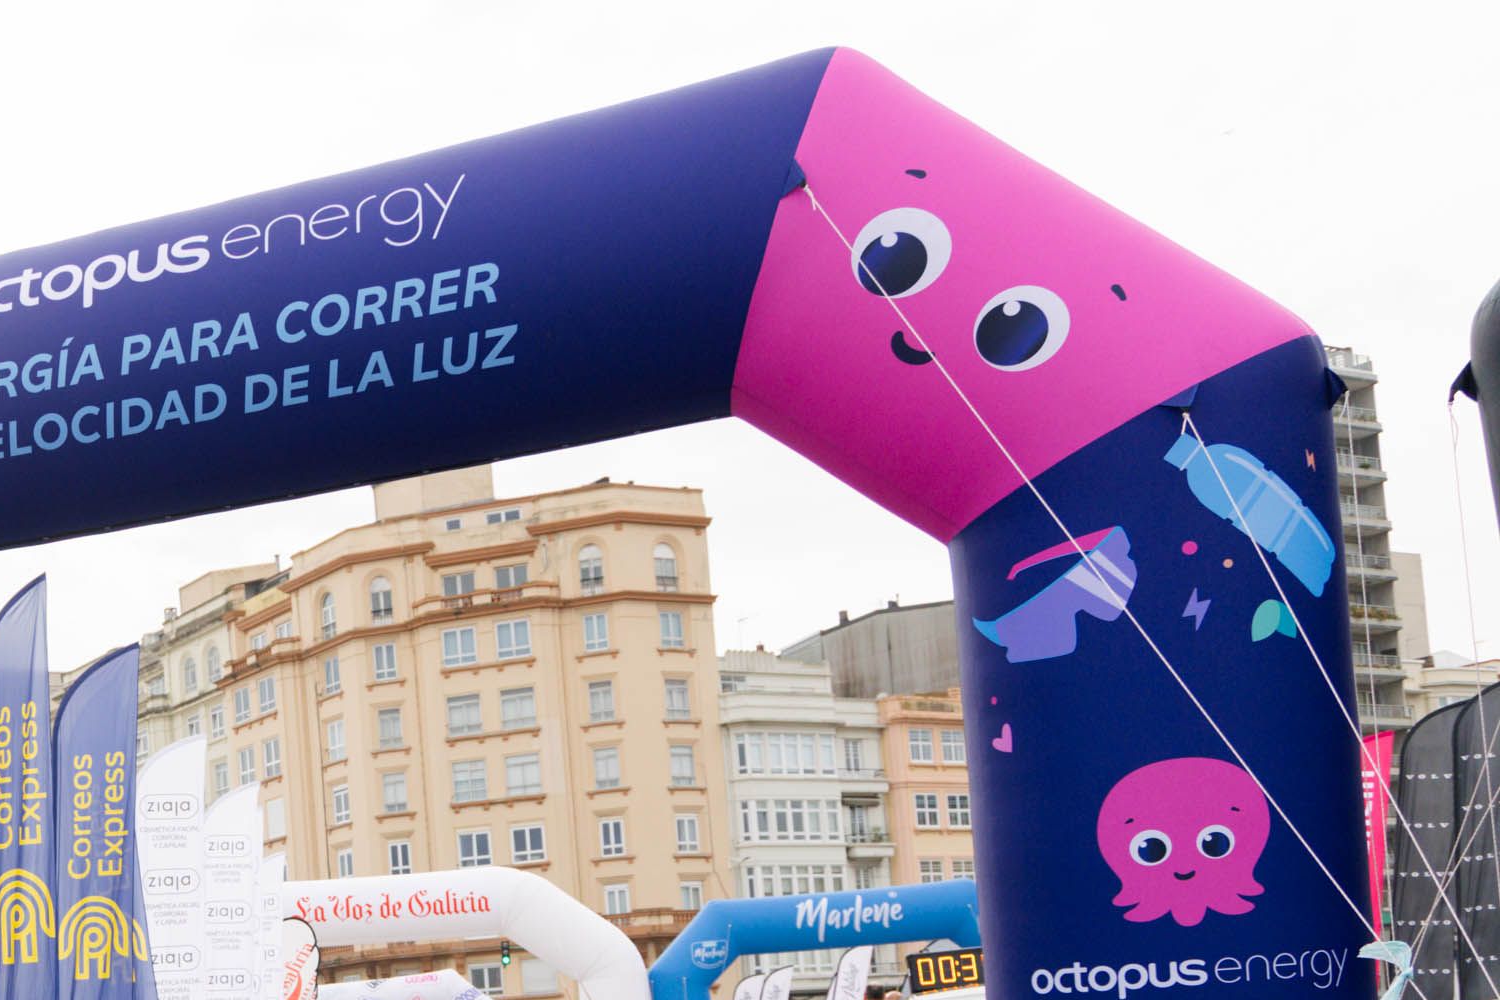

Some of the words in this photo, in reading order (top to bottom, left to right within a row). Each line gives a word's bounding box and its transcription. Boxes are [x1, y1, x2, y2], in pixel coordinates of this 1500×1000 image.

[220, 173, 465, 259] energy
[120, 312, 260, 376] PARA
[276, 262, 500, 343] CORRER
[245, 364, 309, 414] DE
[328, 351, 394, 398] LA
[412, 324, 518, 382] LUZ
[18, 700, 47, 847] Express
[67, 753, 93, 880] Correos
[97, 751, 129, 877] Express
[147, 801, 190, 816] ziaja
[208, 839, 245, 855] ziaja
[148, 875, 191, 891] ziaja
[329, 894, 372, 924] Voz
[379, 893, 402, 920] de
[408, 889, 491, 917] Galicia
[207, 906, 244, 921] ziaja
[795, 895, 904, 942] Marlene
[208, 973, 245, 987] ziaja
[916, 953, 985, 986] 00:3
[1031, 959, 1208, 1000] octopus
[1214, 948, 1348, 988] energy
